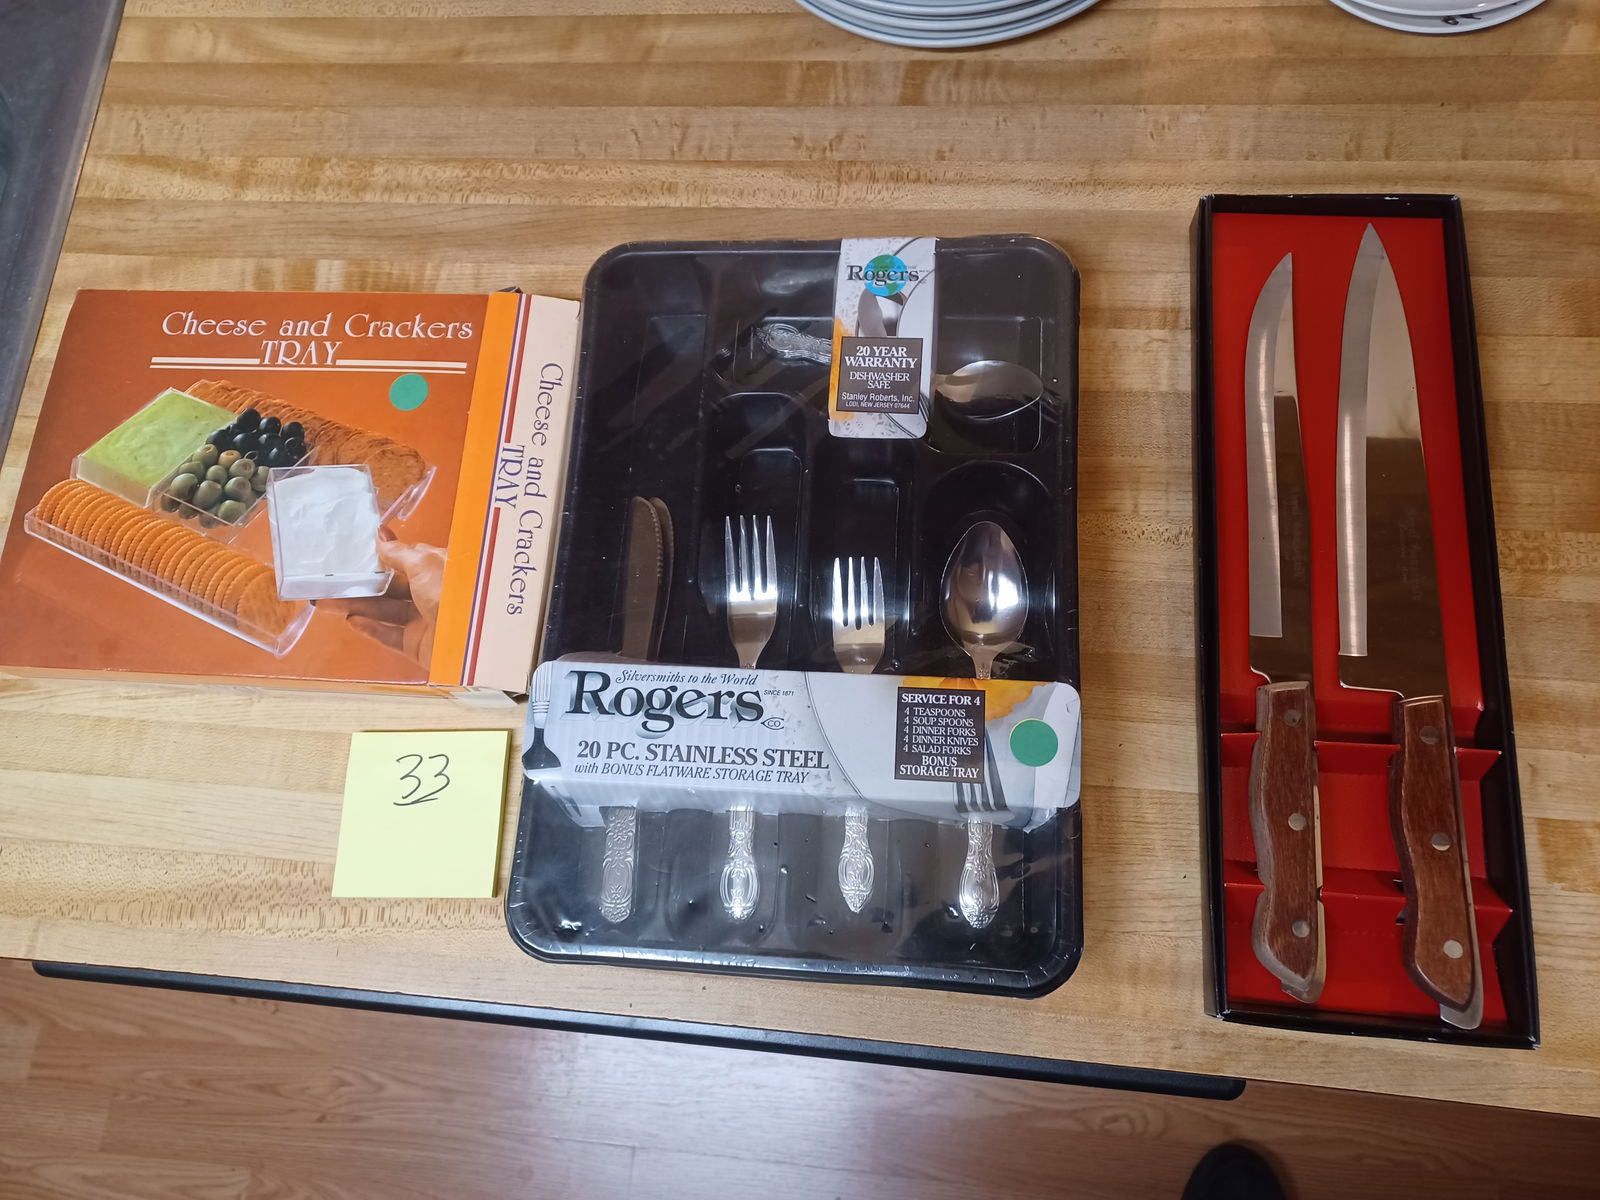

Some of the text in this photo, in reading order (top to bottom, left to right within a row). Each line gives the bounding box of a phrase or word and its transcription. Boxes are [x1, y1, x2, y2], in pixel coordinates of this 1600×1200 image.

[846, 265, 920, 287] Rogers
[161, 310, 473, 340] Cheese and Crackers
[260, 339, 343, 366] TRAY
[856, 345, 907, 357] 20 YEAR
[844, 356, 918, 368] WARRANTY
[849, 371, 910, 382] DISHWASHER
[867, 380, 891, 389] SAFE
[841, 391, 915, 402] Stanley Roberts, Inc.
[494, 444, 525, 509] TRAY
[506, 362, 564, 616] Cheese and Crackers
[615, 669, 759, 686] Silversmiths to the World
[763, 689, 782, 697] SINCE
[564, 669, 765, 734] Rogers
[901, 693, 981, 706] SERVICE FOR 4
[904, 707, 966, 717] 4 TEASPOONS
[767, 719, 781, 728] CO
[904, 716, 974, 727] 4 SOUP SPOONS
[903, 725, 976, 737] 4 DINNER FORKS
[903, 735, 979, 746] 4 DINNER KNIVES
[577, 740, 830, 770] 20 PC. STAINLESS STEEL
[903, 744, 971, 755] 4 SALAD FORKS
[922, 755, 958, 767] BONUS
[574, 762, 810, 784] with BONUS FLATWARE STORAGE TRAY
[899, 764, 979, 778] STORAGE TRAY
[394, 754, 450, 805] 33
